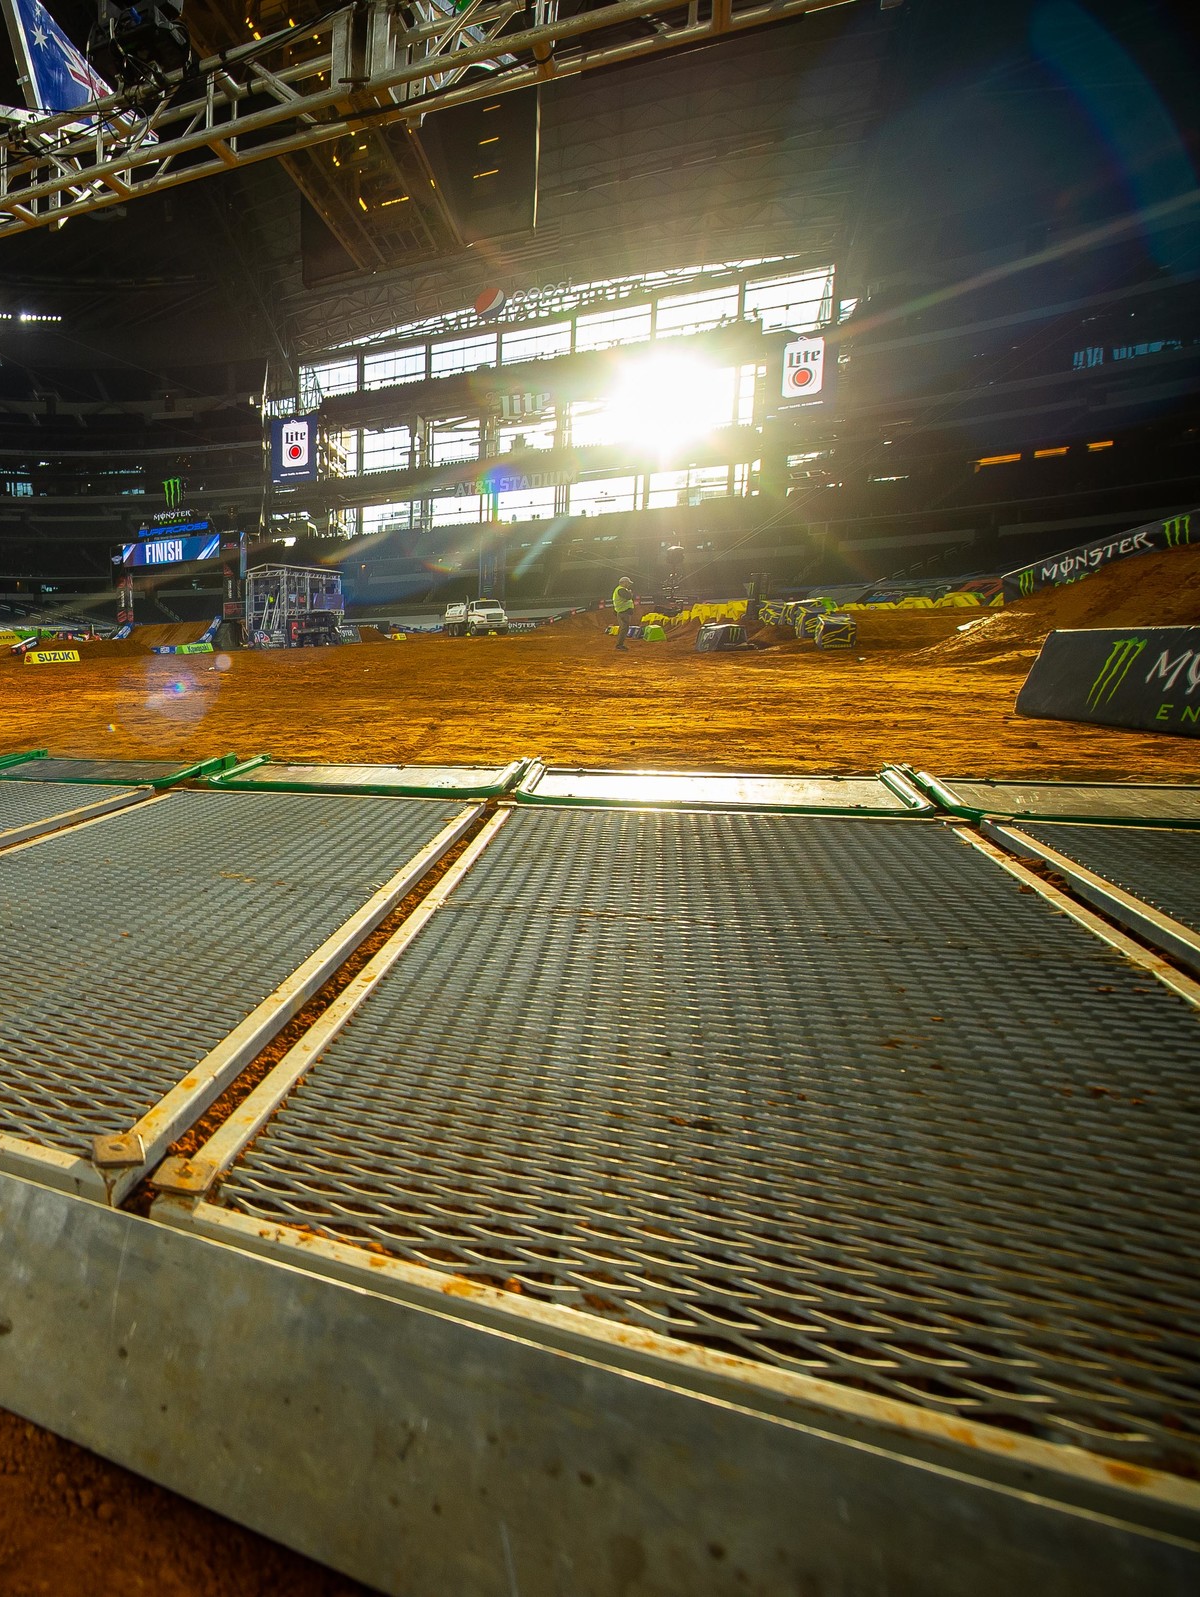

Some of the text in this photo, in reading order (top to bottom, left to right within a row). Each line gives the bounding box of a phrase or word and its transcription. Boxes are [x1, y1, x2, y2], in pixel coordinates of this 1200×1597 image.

[511, 276, 573, 306] pepsi
[787, 350, 821, 368] Lite
[499, 392, 551, 420] Lite
[285, 431, 306, 444] Lite
[455, 470, 577, 498] AT&T STADIUM
[153, 509, 191, 521] MONSTER
[138, 522, 209, 538] SUPERCROSS
[145, 541, 183, 564] FINISH
[1041, 531, 1155, 581] MONSTER
[37, 652, 76, 663] SUZUKI
